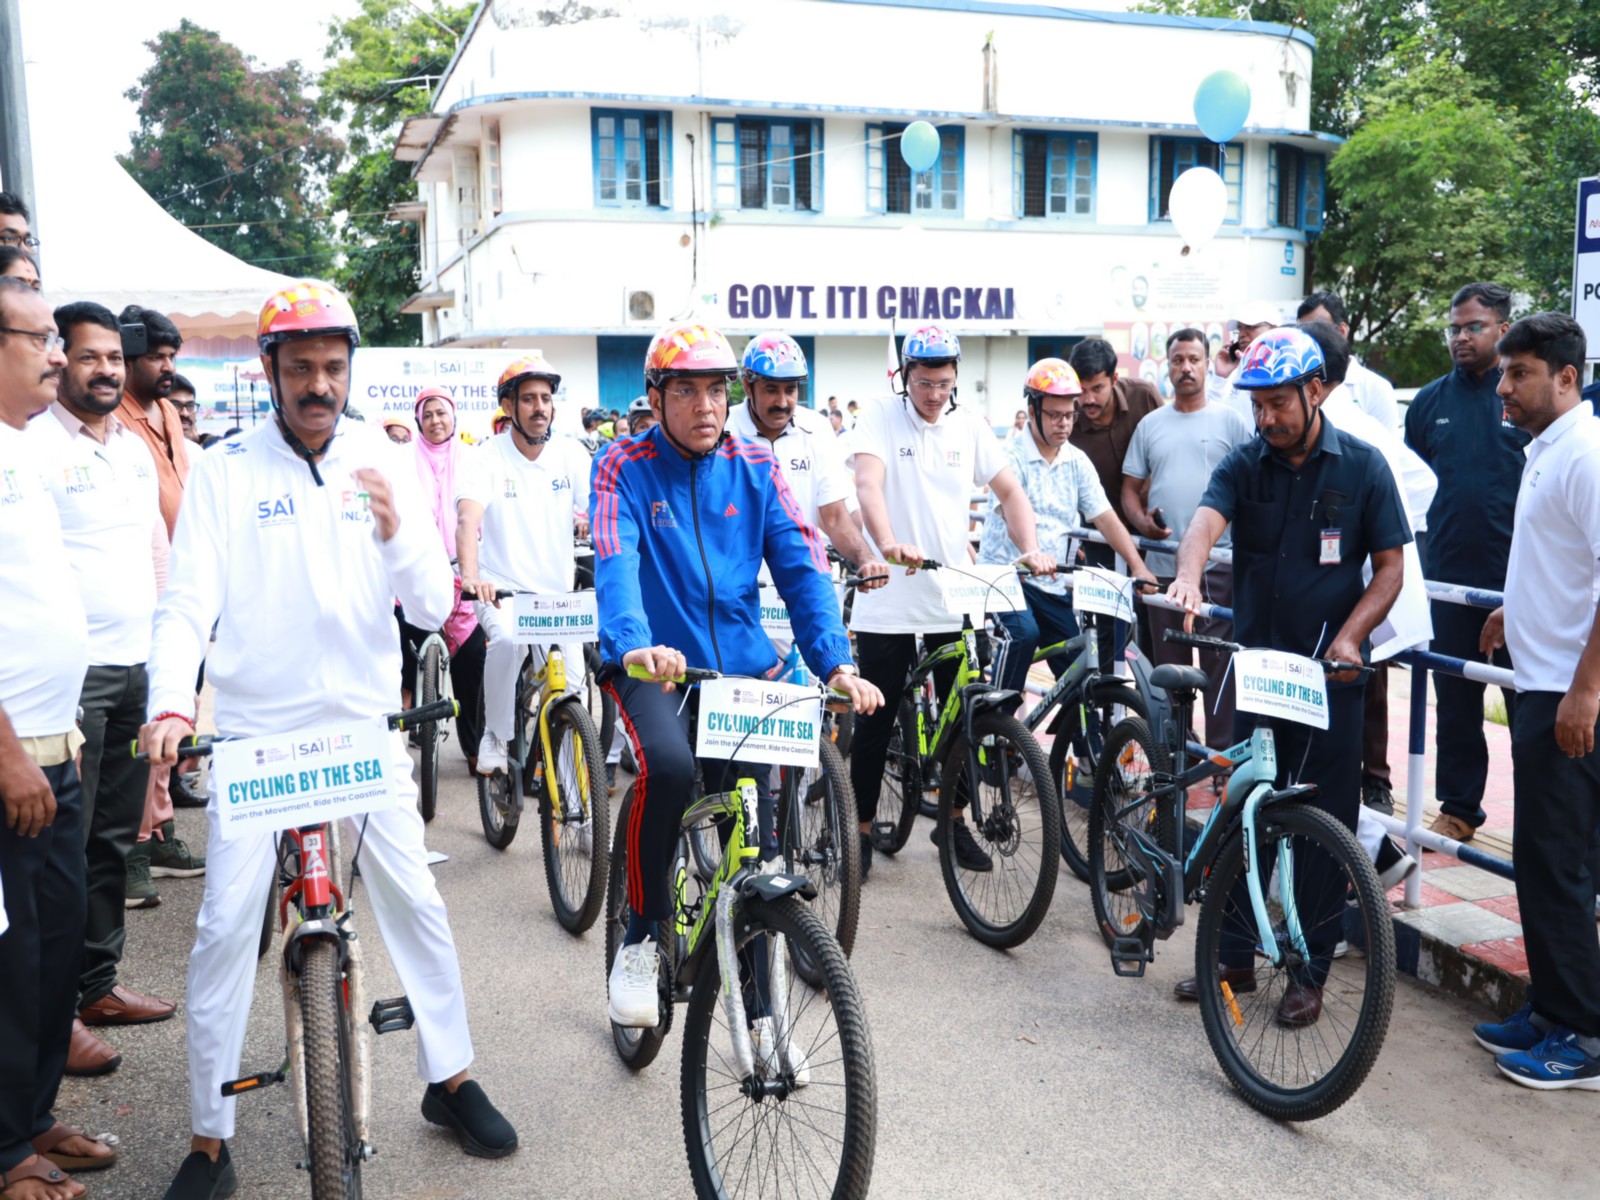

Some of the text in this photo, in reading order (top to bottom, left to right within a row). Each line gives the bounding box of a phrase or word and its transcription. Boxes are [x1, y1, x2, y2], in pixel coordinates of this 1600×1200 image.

[728, 284, 1014, 319] GOVT. ITI CHACKAI
[367, 385, 424, 398] CYCLIN
[439, 385, 457, 398] Y
[461, 385, 483, 398] THE
[383, 402, 391, 411] A
[471, 402, 488, 411] LED
[491, 402, 498, 411] B
[790, 456, 811, 471] SAI
[63, 465, 91, 484] FIT
[66, 483, 97, 495] INDIA
[552, 475, 571, 491] SAI
[257, 494, 295, 519] SAI
[341, 511, 371, 523] INDA
[518, 614, 593, 627] CYCLING BY THE SEA
[760, 606, 790, 620] CYCLIN
[766, 692, 783, 705] SAI
[1243, 675, 1323, 707] CYCLING BY THE SEA
[707, 711, 814, 740] CYCLING BY THE SEA
[299, 738, 325, 756] SAI
[705, 738, 719, 746] Join
[768, 744, 780, 752] Ride
[228, 758, 383, 804] CYCLING BY THE SEA
[229, 788, 387, 822] Join the Movement, Ride the Coastline
[309, 838, 318, 847] 33
